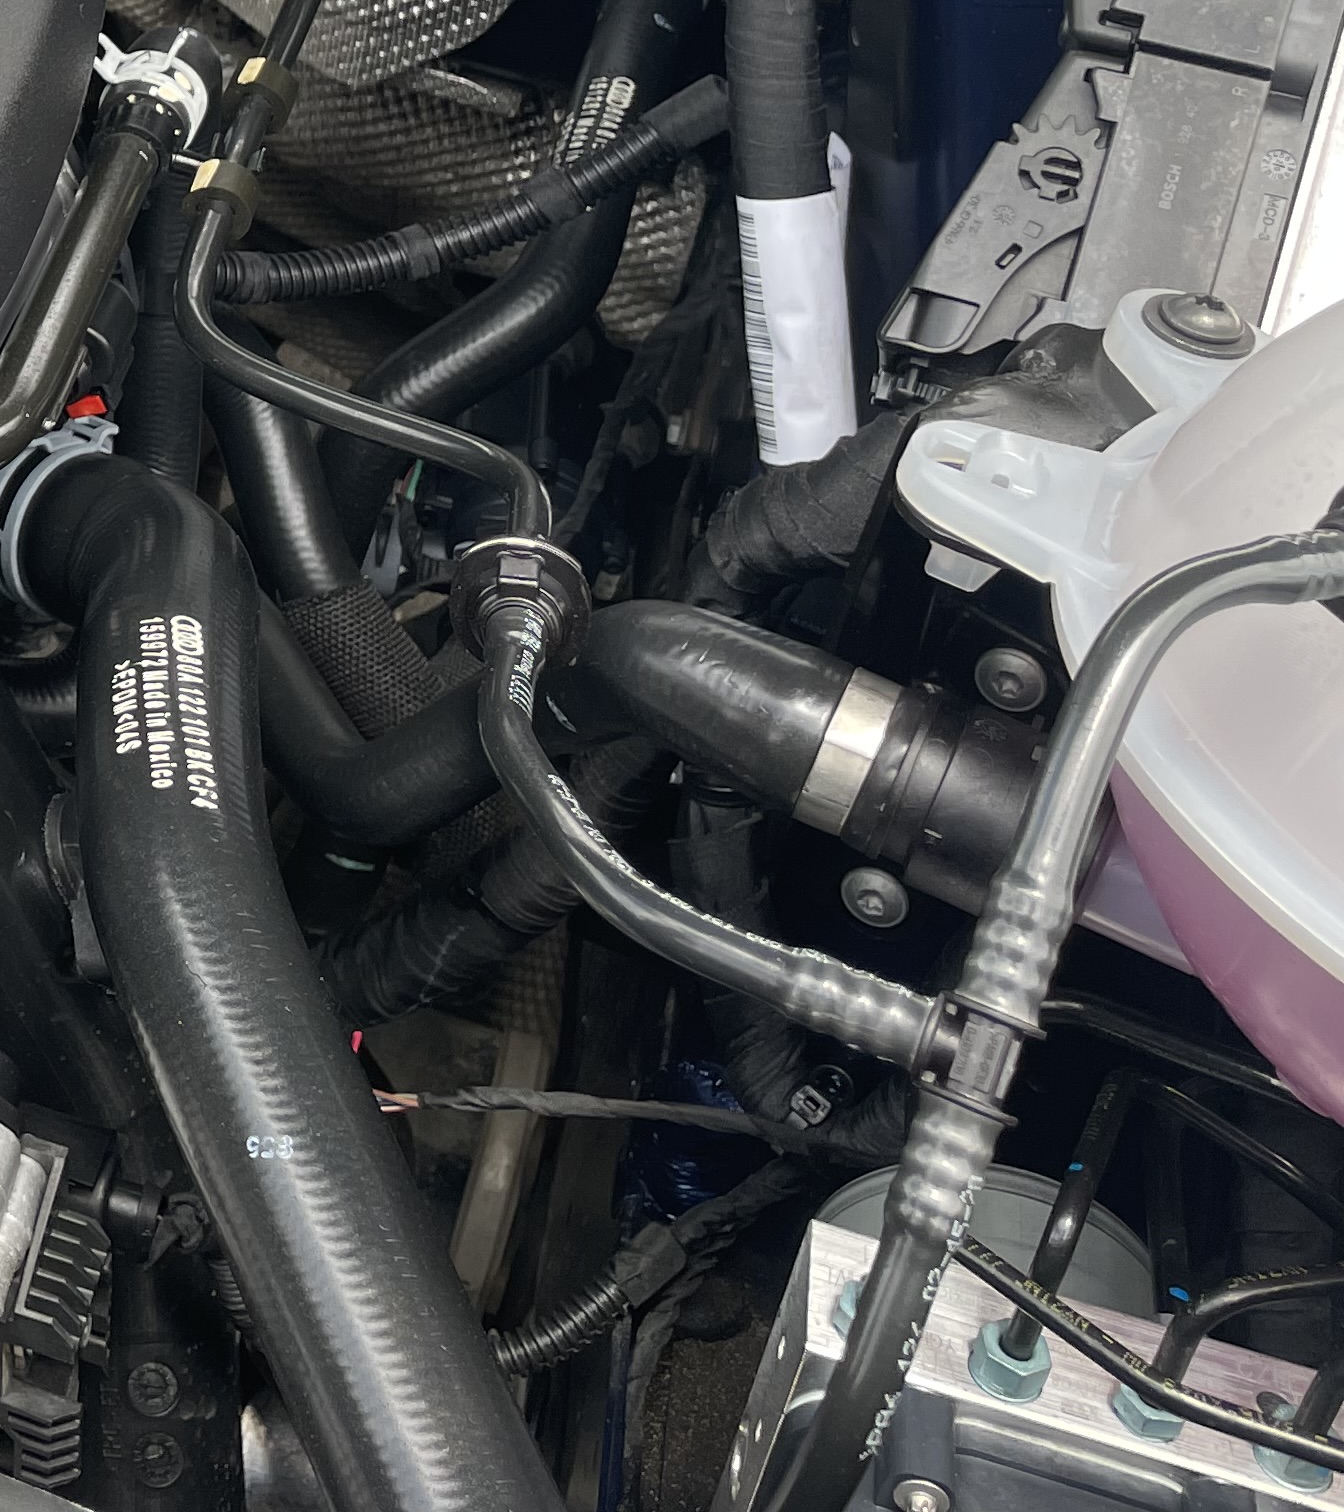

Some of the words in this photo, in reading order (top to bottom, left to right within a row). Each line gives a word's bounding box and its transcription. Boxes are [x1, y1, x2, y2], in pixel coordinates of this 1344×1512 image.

[1158, 164, 1183, 210] BOSCH
[1258, 197, 1281, 241] MCD-3
[176, 654, 204, 683] 80A
[142, 670, 171, 709] Made
[177, 687, 208, 715] 122
[145, 711, 172, 728] in
[180, 717, 211, 747] 101
[147, 730, 177, 789] Mexico
